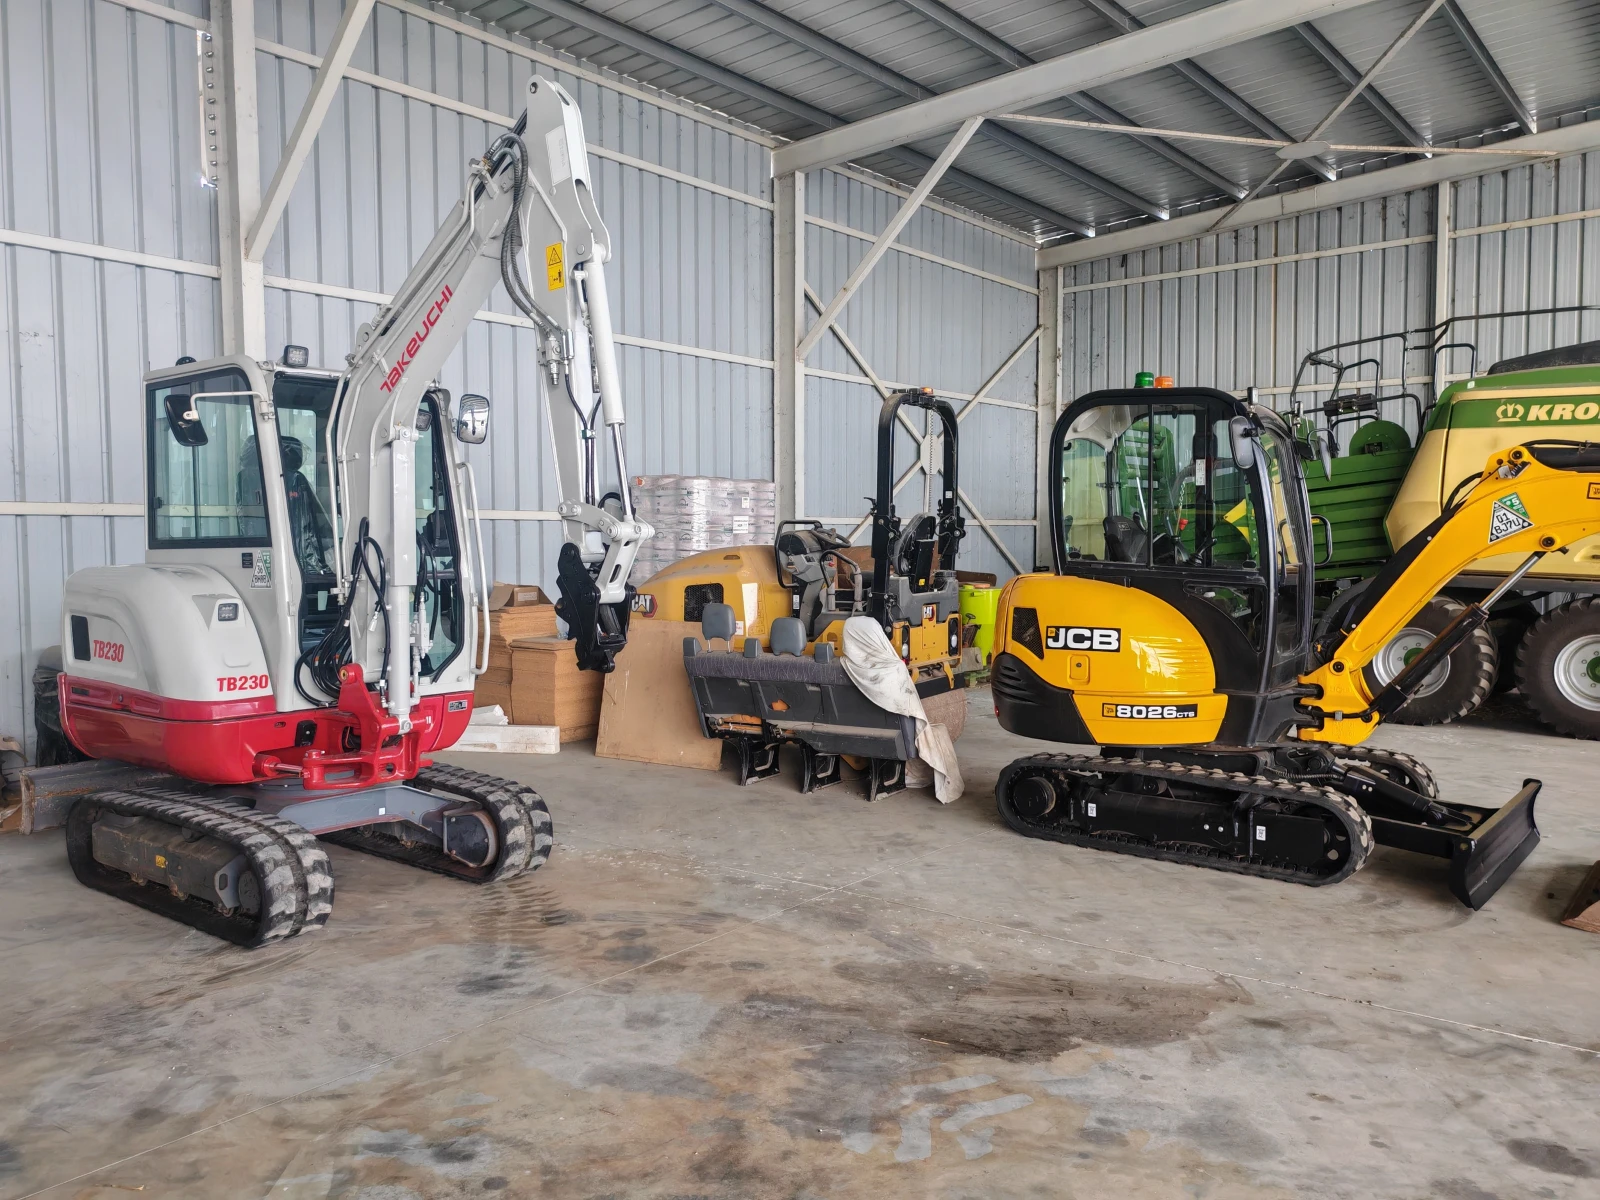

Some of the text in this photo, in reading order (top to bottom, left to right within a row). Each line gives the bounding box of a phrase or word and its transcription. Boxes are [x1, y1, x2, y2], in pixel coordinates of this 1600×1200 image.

[1526, 402, 1600, 421] KRO
[631, 594, 652, 612] CAT
[1047, 627, 1119, 650] JCB
[93, 639, 125, 663] TB230
[216, 674, 269, 692] TB230
